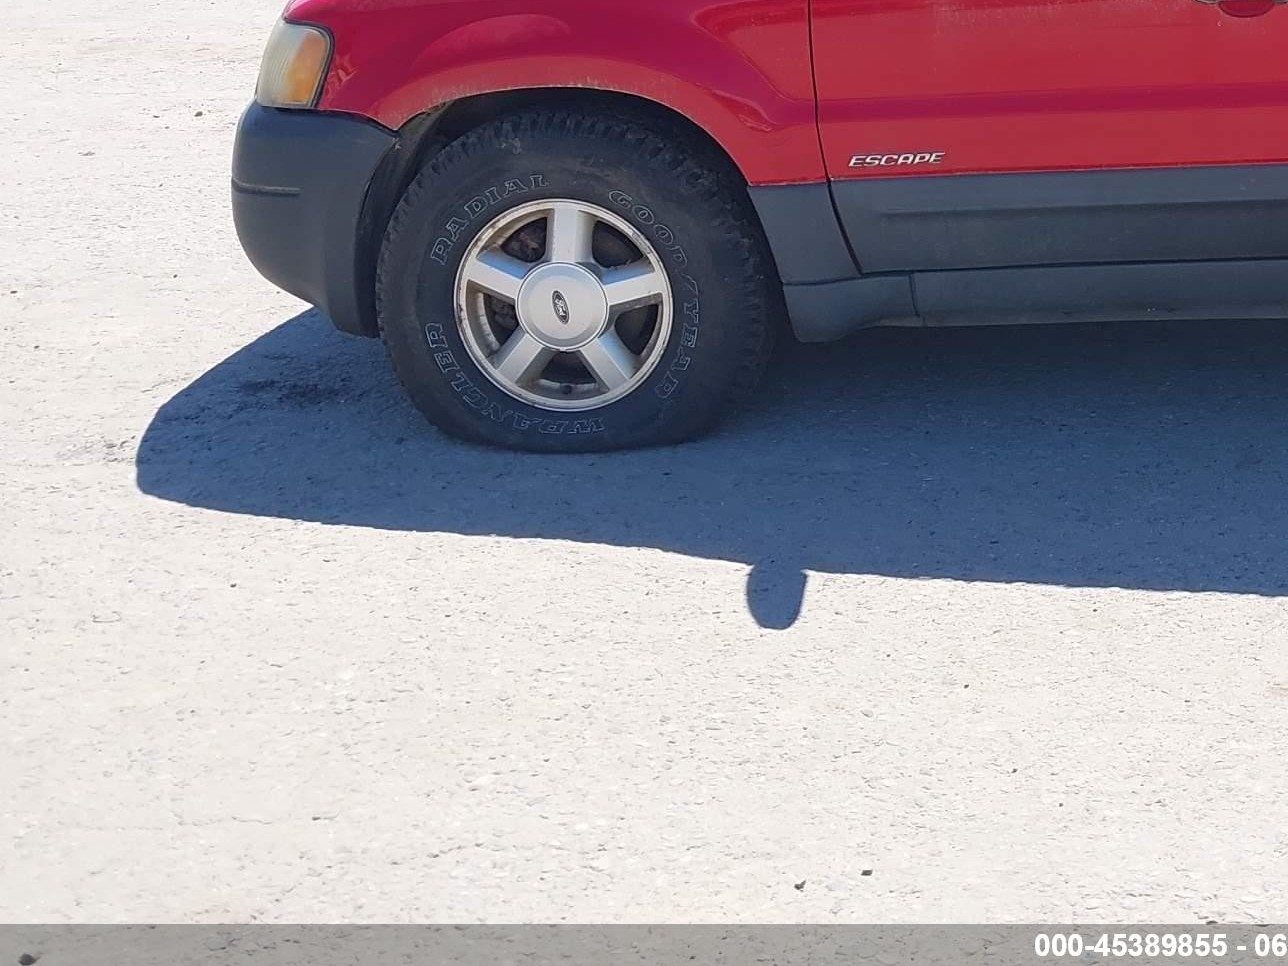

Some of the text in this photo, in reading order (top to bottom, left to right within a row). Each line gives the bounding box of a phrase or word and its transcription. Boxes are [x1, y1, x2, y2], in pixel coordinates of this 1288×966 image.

[848, 152, 945, 167] ESCAPE
[430, 173, 551, 266] RADIAL
[425, 322, 605, 435] WRANGLER
